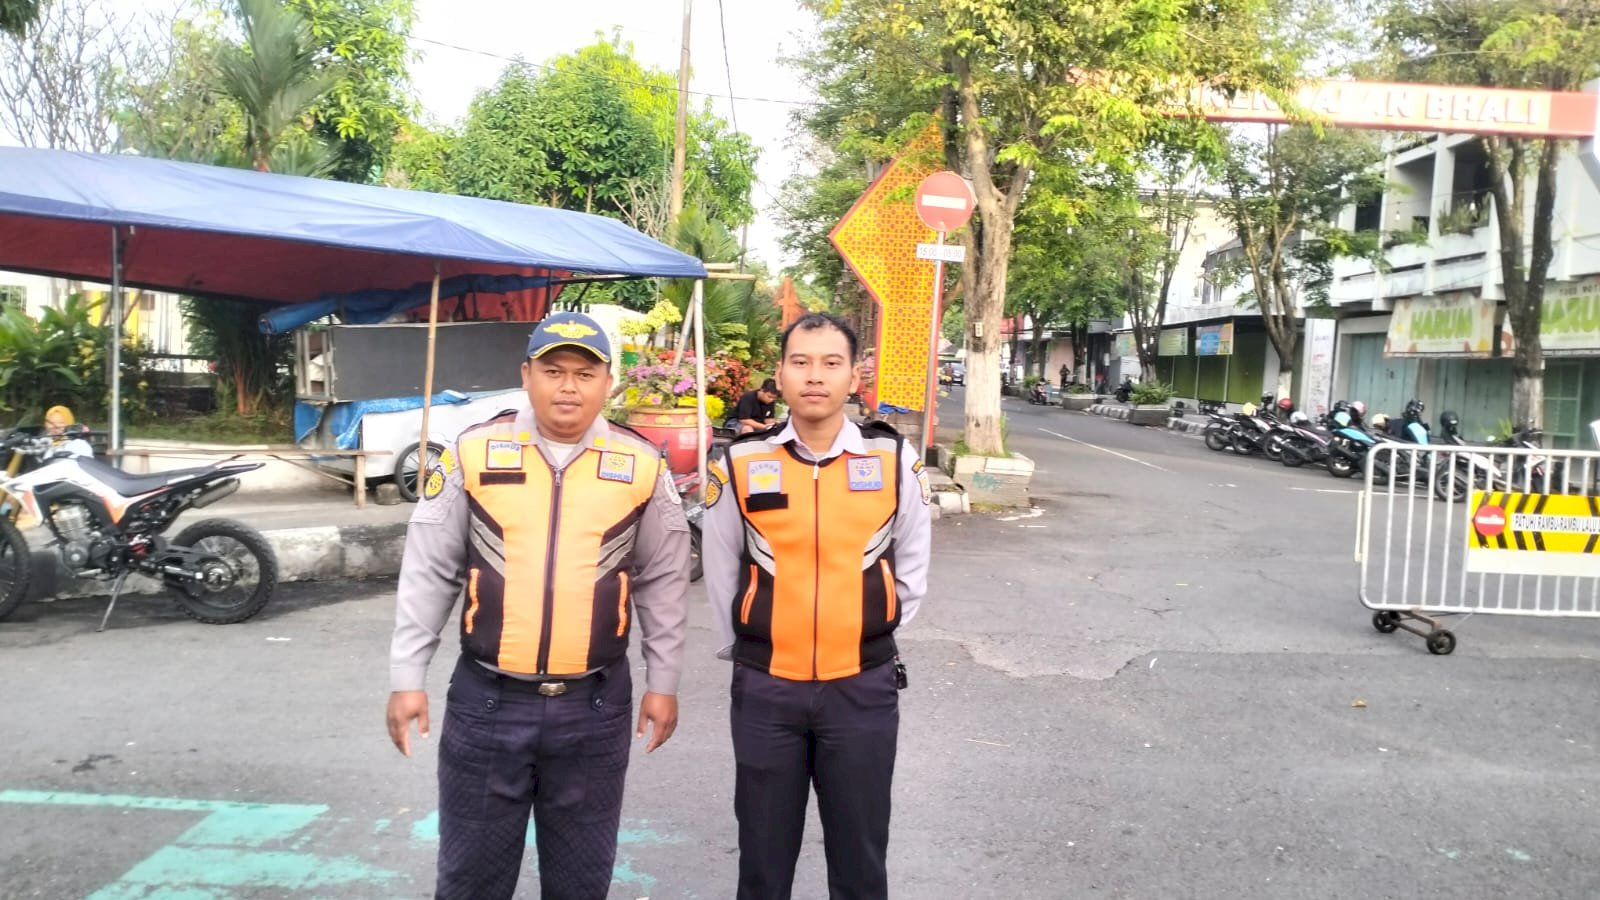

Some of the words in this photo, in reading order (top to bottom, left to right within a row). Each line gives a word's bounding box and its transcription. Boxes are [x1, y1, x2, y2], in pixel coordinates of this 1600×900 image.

[1424, 92, 1538, 126] BHALI
[1409, 308, 1473, 340] HARUM
[601, 471, 631, 481] DISHUB
[850, 481, 881, 490] DISHUB
[1514, 514, 1536, 530] PATUHI
[1538, 516, 1579, 532] RAMBU-RAMBU
